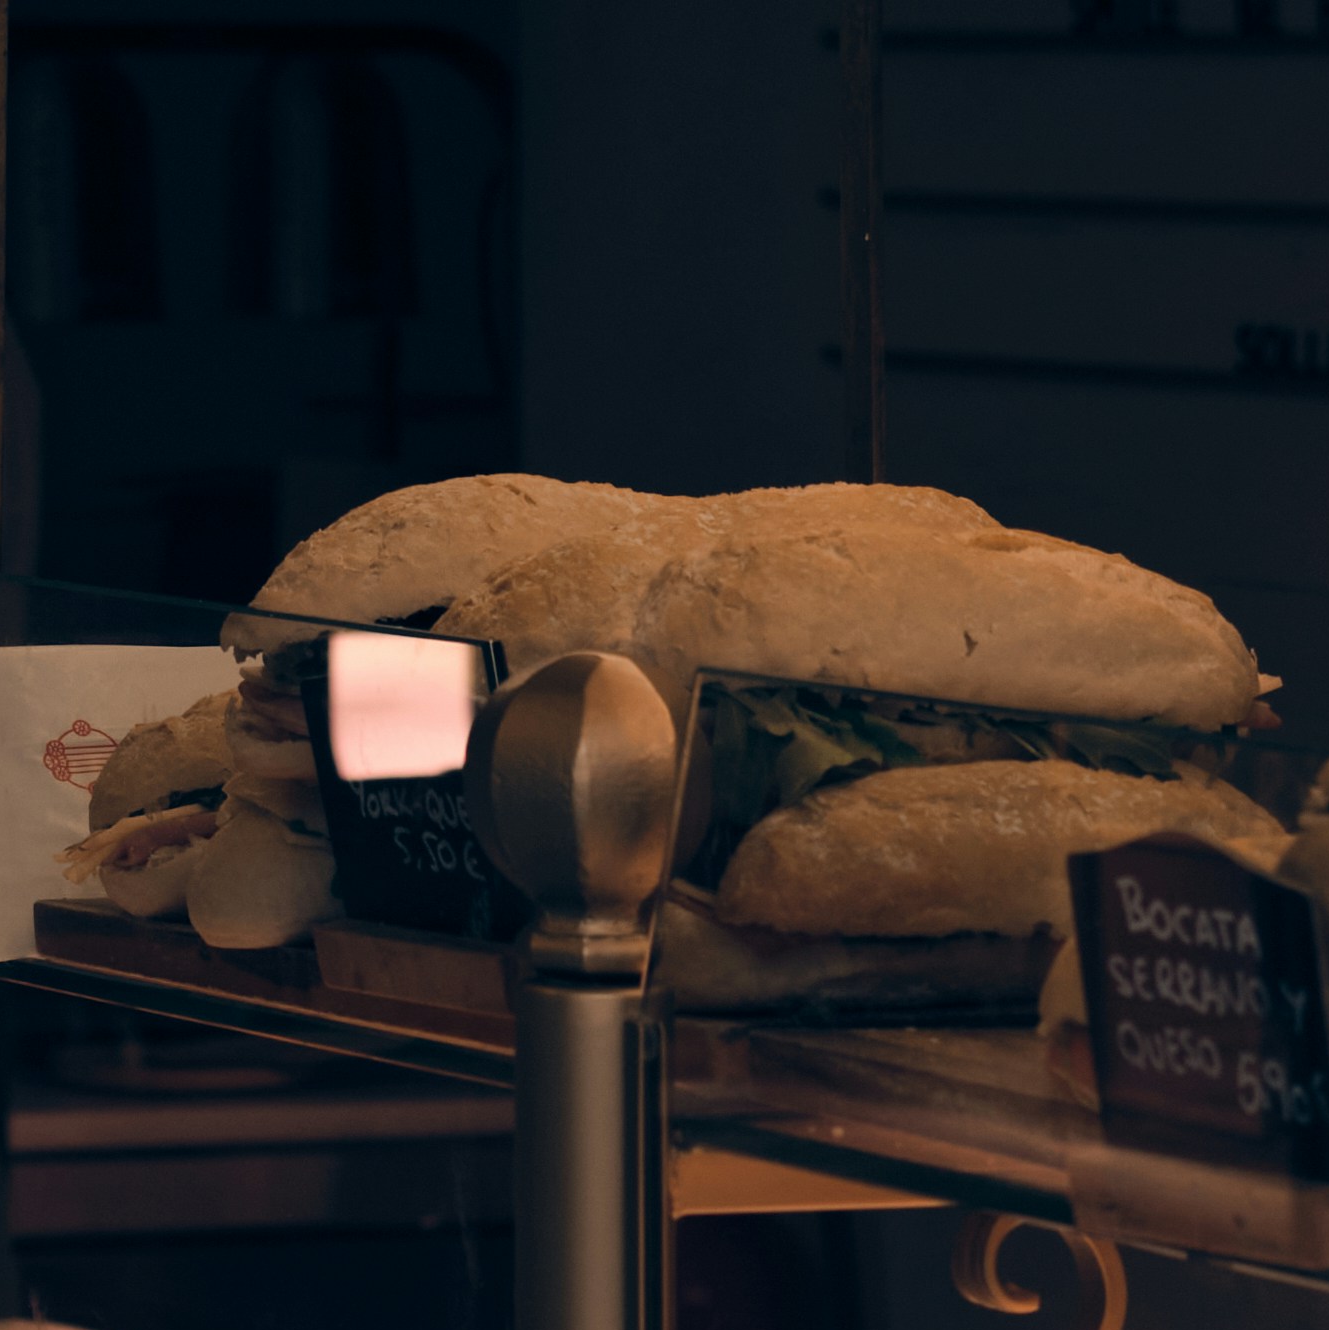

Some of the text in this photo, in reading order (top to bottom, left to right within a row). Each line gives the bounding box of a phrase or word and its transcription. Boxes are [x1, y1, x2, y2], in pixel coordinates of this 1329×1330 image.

[1116, 875, 1264, 961] BOCATA
[1107, 954, 1308, 1034] SERRANO Y
[1117, 1021, 1223, 1080] QUESO
